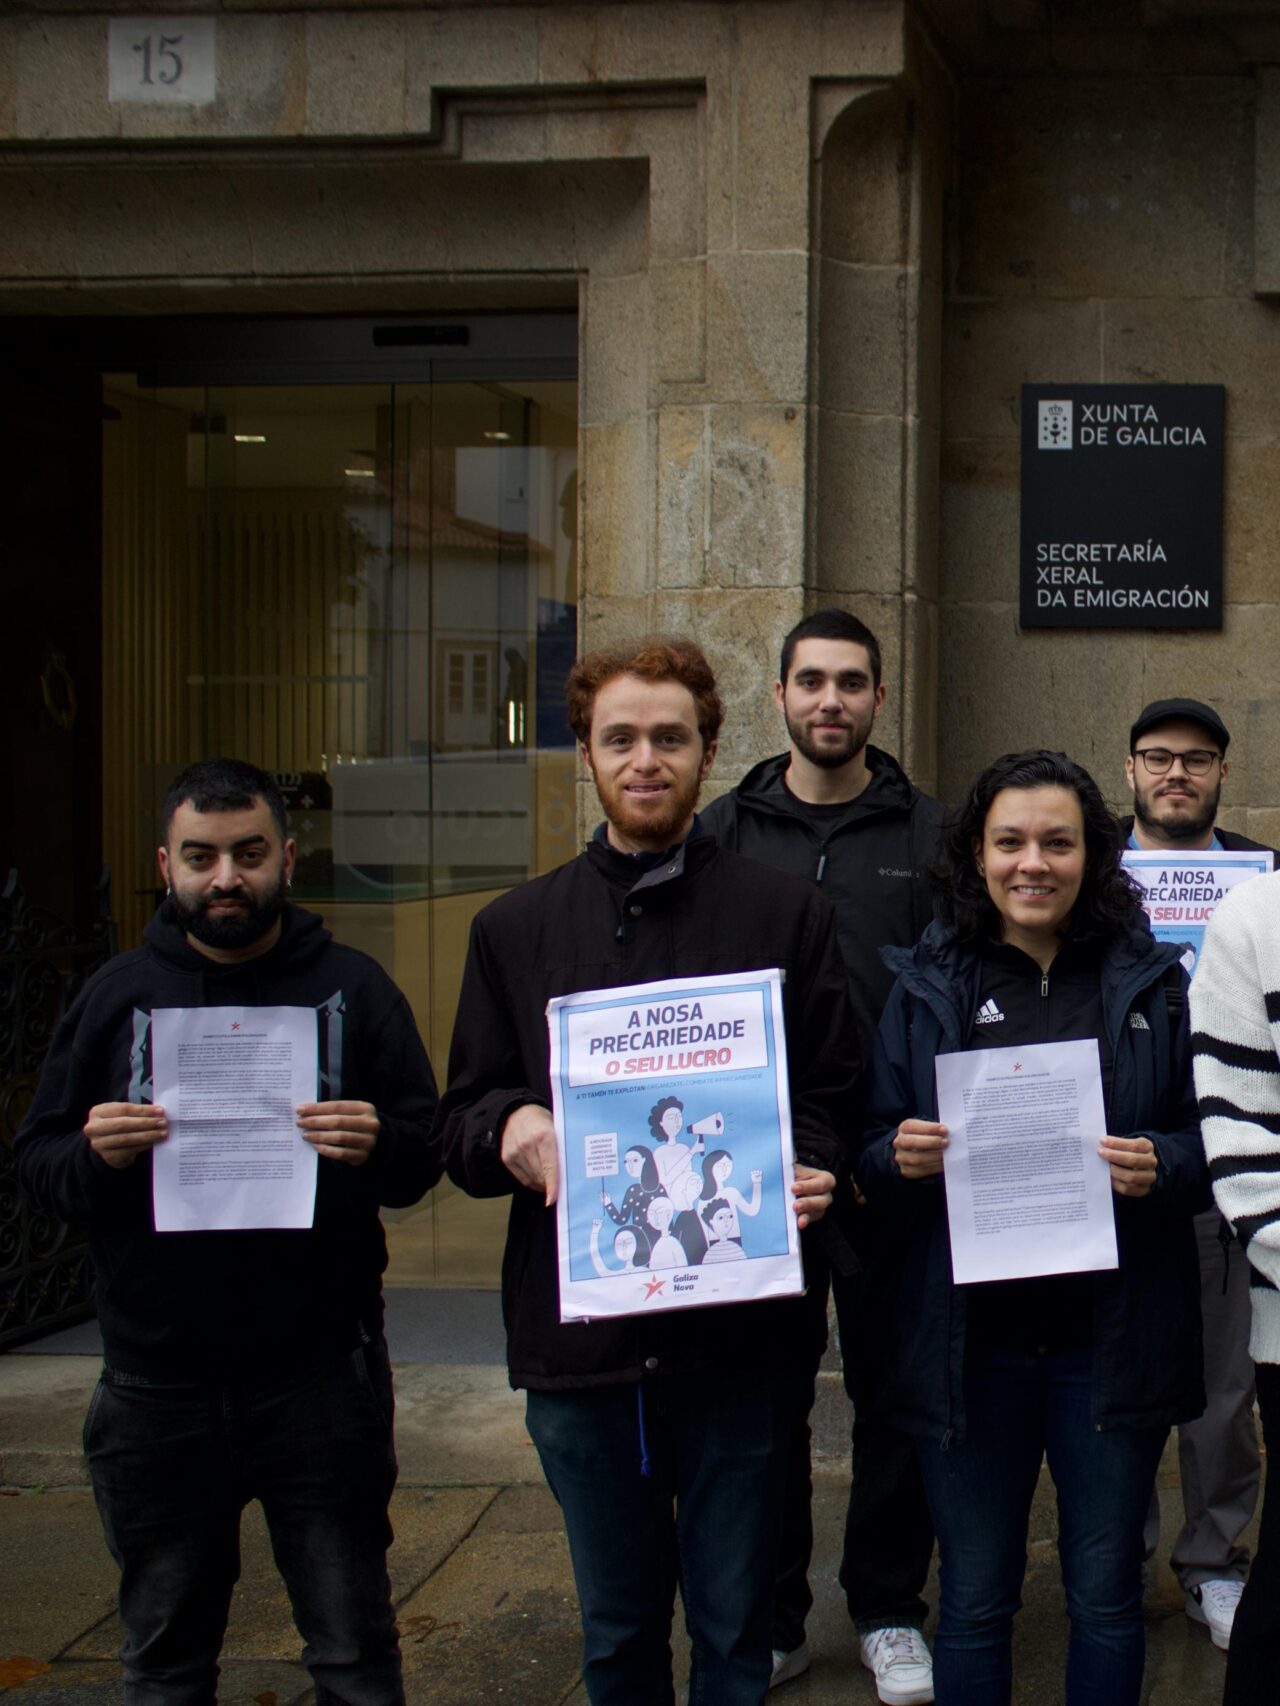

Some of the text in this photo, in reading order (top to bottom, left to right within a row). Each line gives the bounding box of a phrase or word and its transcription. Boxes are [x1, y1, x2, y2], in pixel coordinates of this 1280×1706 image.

[132, 35, 184, 86] 15
[1081, 404, 1159, 423] XUNTA
[1081, 427, 1207, 446] DE GALICIA
[1036, 539, 1167, 562] SECRETARÍA
[1036, 566, 1104, 585] XERAL
[1037, 584, 1209, 608] DA EMIGRACIÓN
[1158, 871, 1215, 885] A NOSA
[1139, 888, 1231, 902] RECARIEDA
[1153, 907, 1183, 921] SEU
[1186, 907, 1215, 921] LUC
[627, 1003, 704, 1029] A NOSA
[975, 1012, 1005, 1025] adidas
[589, 1019, 746, 1056] PRECARIEDADE
[605, 1047, 732, 1076] O SEU LUCRO
[673, 1273, 699, 1283] Galiza
[673, 1284, 695, 1292] Nova
